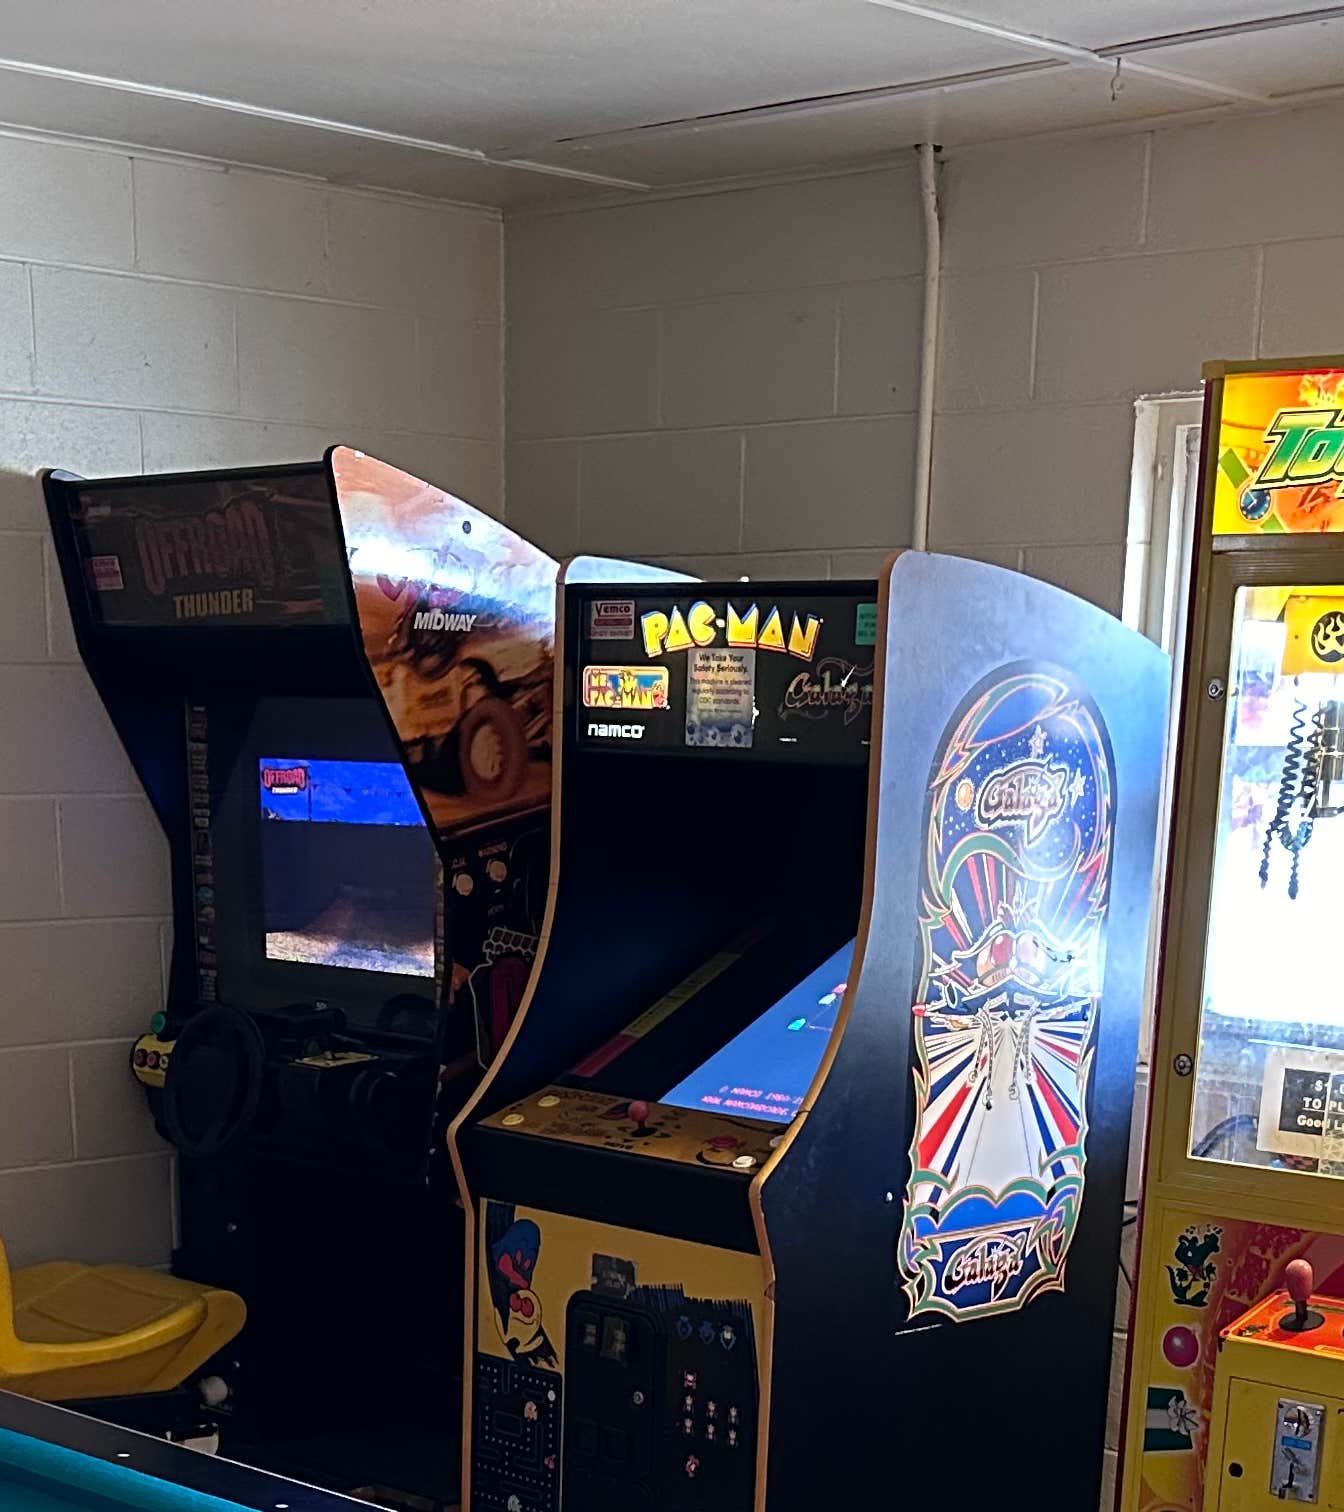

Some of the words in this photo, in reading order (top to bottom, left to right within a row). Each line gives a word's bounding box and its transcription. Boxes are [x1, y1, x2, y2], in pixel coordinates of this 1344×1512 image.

[173, 588, 253, 618] THUNDER
[595, 603, 632, 617] Vemco
[414, 612, 476, 632] MIDWAY
[641, 601, 820, 661] PAC-MAN
[588, 724, 645, 738] namco
[1303, 1097, 1322, 1110] TO
[1297, 1115, 1331, 1129] Good
[942, 1233, 1027, 1301] Galaga
